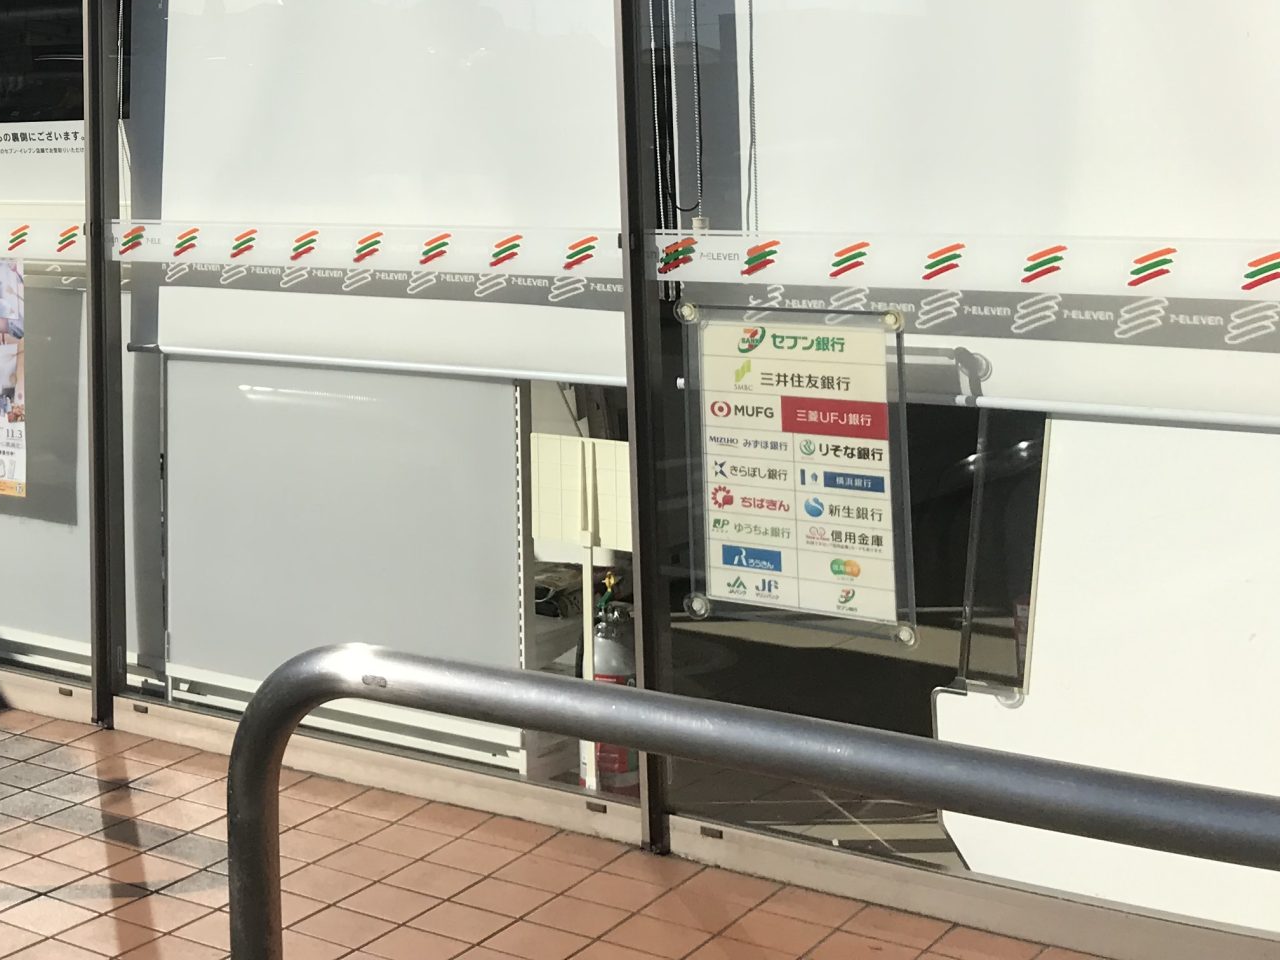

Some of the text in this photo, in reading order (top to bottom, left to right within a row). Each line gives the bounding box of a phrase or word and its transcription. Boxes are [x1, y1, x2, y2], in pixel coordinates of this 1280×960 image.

[771, 333, 845, 352] セブン銀行
[760, 372, 851, 391] 三井住友銀行
[734, 405, 774, 418] MUFG
[796, 409, 872, 427] 三菱UFJ銀行
[742, 439, 788, 451] みずほ銀行
[818, 442, 884, 461] りそな銀行
[729, 465, 788, 481] きらぼし銀行
[828, 503, 883, 522] 新生銀行
[733, 522, 791, 539] ゆうちょ銀行
[830, 529, 884, 547] 信用金庫
